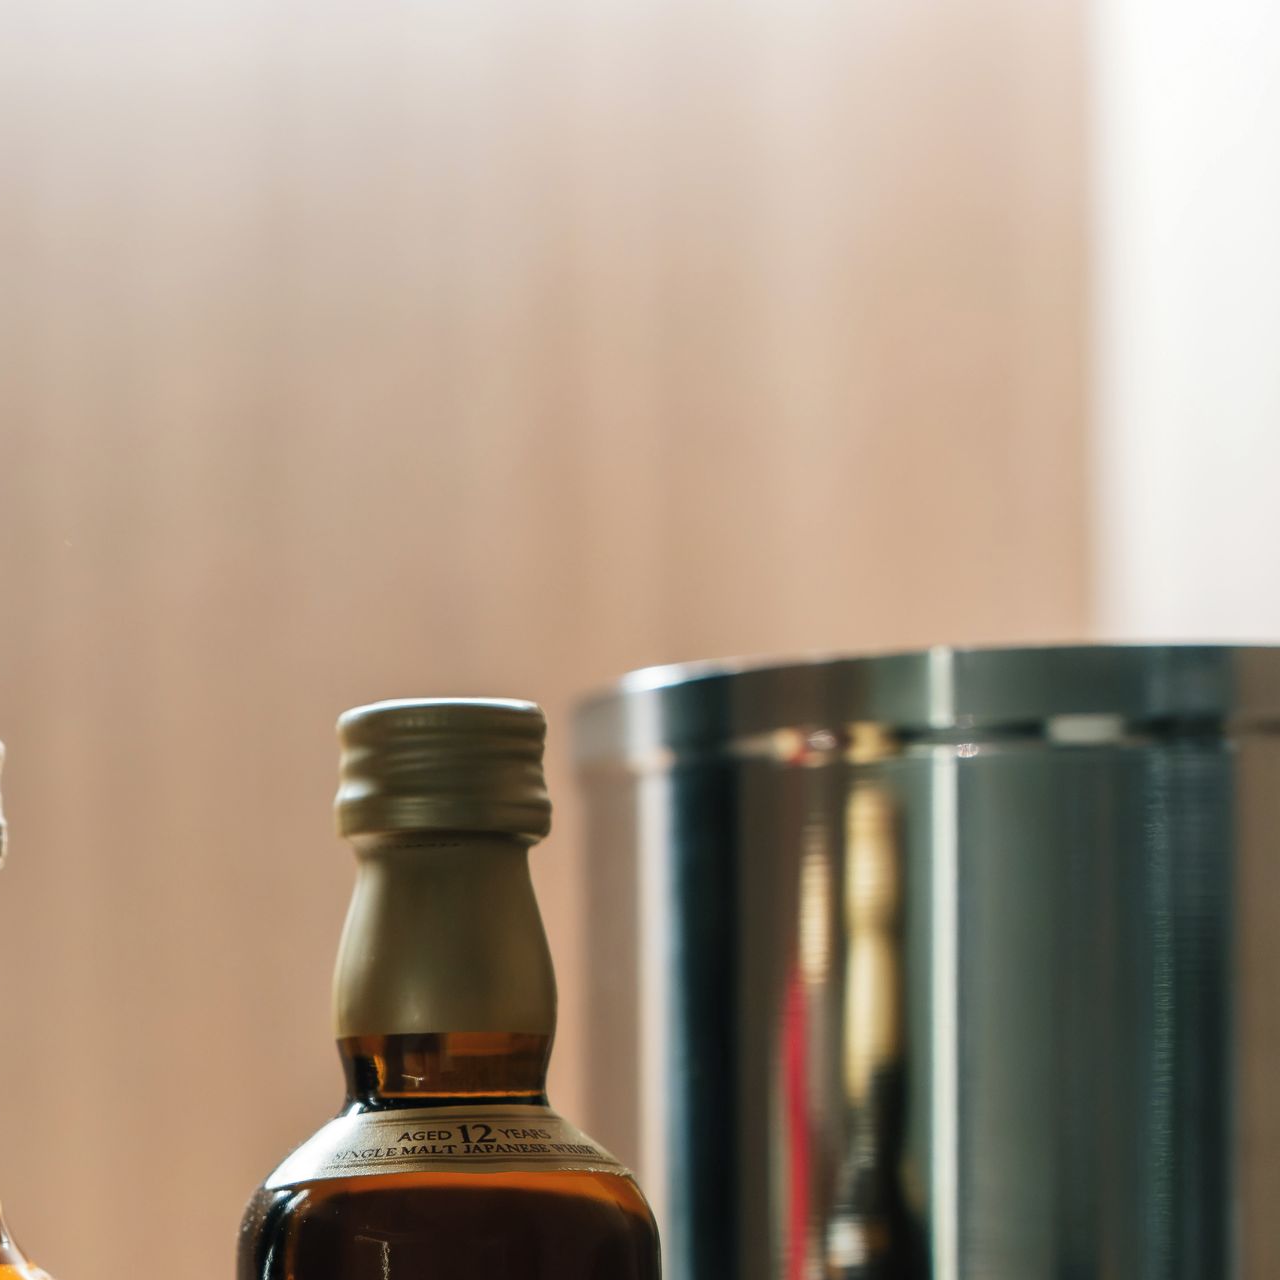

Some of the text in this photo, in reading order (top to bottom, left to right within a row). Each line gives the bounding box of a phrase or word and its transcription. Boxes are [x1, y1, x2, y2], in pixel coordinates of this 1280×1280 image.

[397, 1124, 551, 1143] AGED 12 YEARS
[336, 1147, 398, 1160] SINGLE
[401, 1144, 457, 1155] MALT
[463, 1143, 551, 1154] JAPANESE
